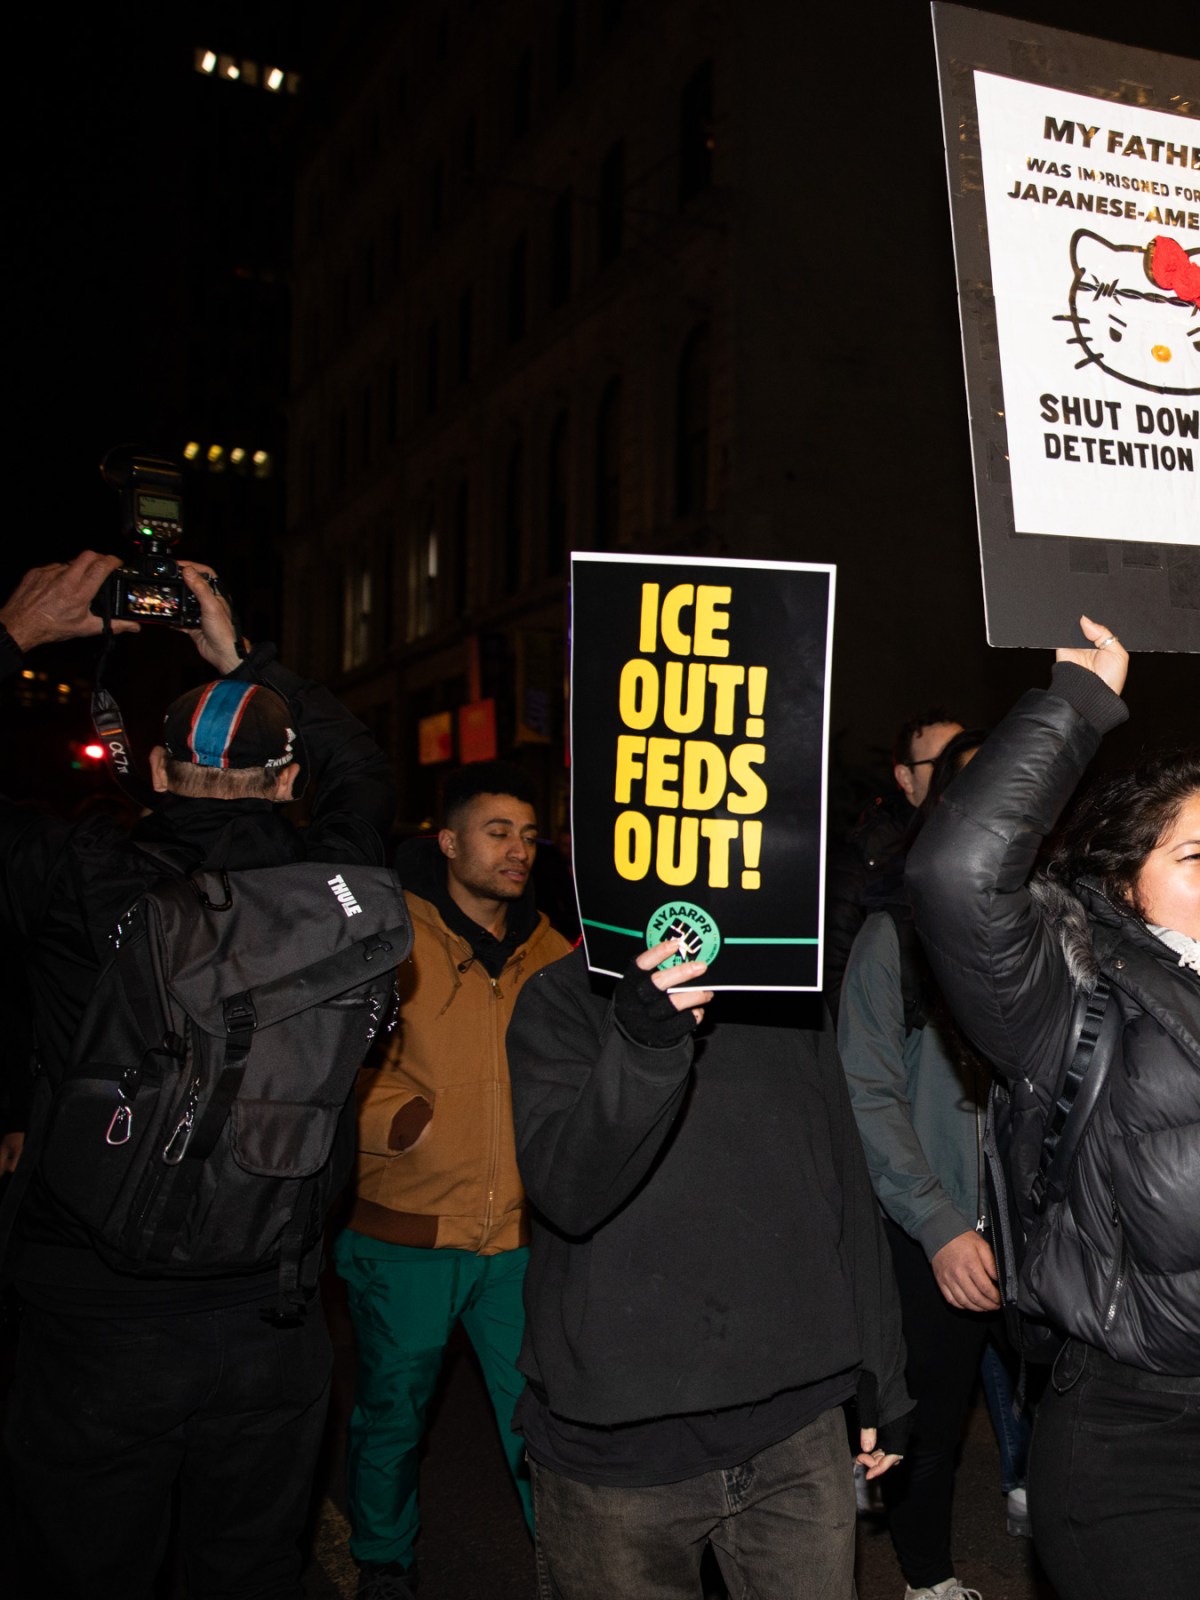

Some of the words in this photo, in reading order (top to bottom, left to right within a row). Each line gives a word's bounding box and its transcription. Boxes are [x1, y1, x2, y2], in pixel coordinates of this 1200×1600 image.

[1043, 116, 1100, 148] MY
[1026, 157, 1071, 178] WAS
[1039, 393, 1121, 430] SHUT
[1044, 432, 1194, 472] DETENTION
[639, 583, 732, 657] ICE
[618, 658, 768, 738] OUT!
[614, 734, 768, 815] FEDS
[613, 810, 763, 890] OUT!
[327, 874, 363, 917] THULE
[653, 906, 712, 934] NYAARPR
